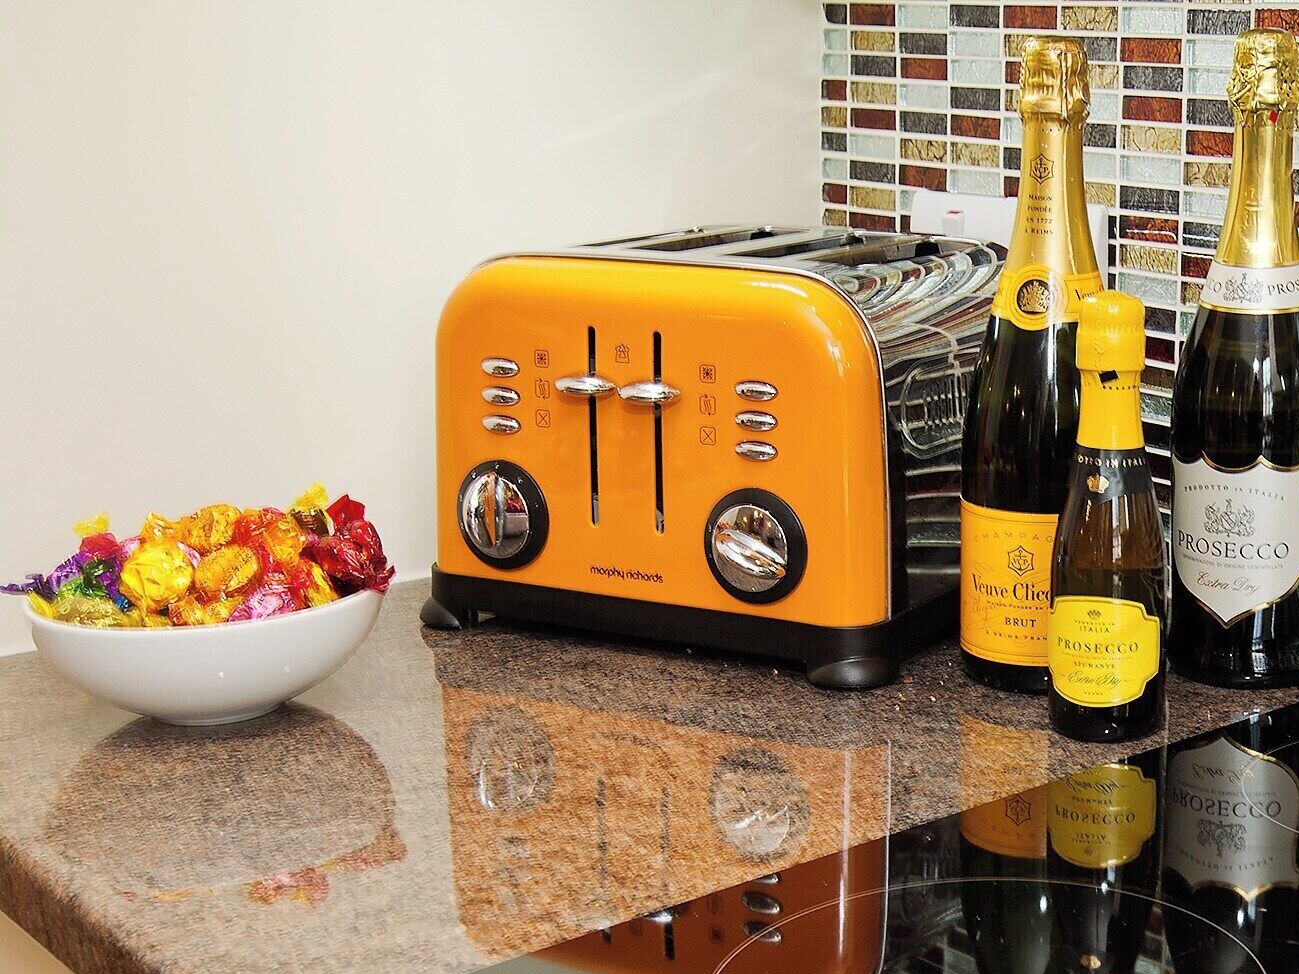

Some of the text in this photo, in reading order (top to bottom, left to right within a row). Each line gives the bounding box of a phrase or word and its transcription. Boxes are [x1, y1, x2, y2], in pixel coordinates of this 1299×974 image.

[1105, 458, 1119, 469] IN
[973, 529, 1054, 543] CHAMPAG
[1178, 530, 1290, 560] PROSECCO
[590, 566, 664, 584] morphy richards
[972, 573, 1008, 599] Veuve
[1196, 571, 1261, 598] Extra Dry
[1004, 616, 1037, 628] BRUT
[1079, 626, 1111, 634] ITALIA
[1057, 636, 1139, 655] PROSECCO
